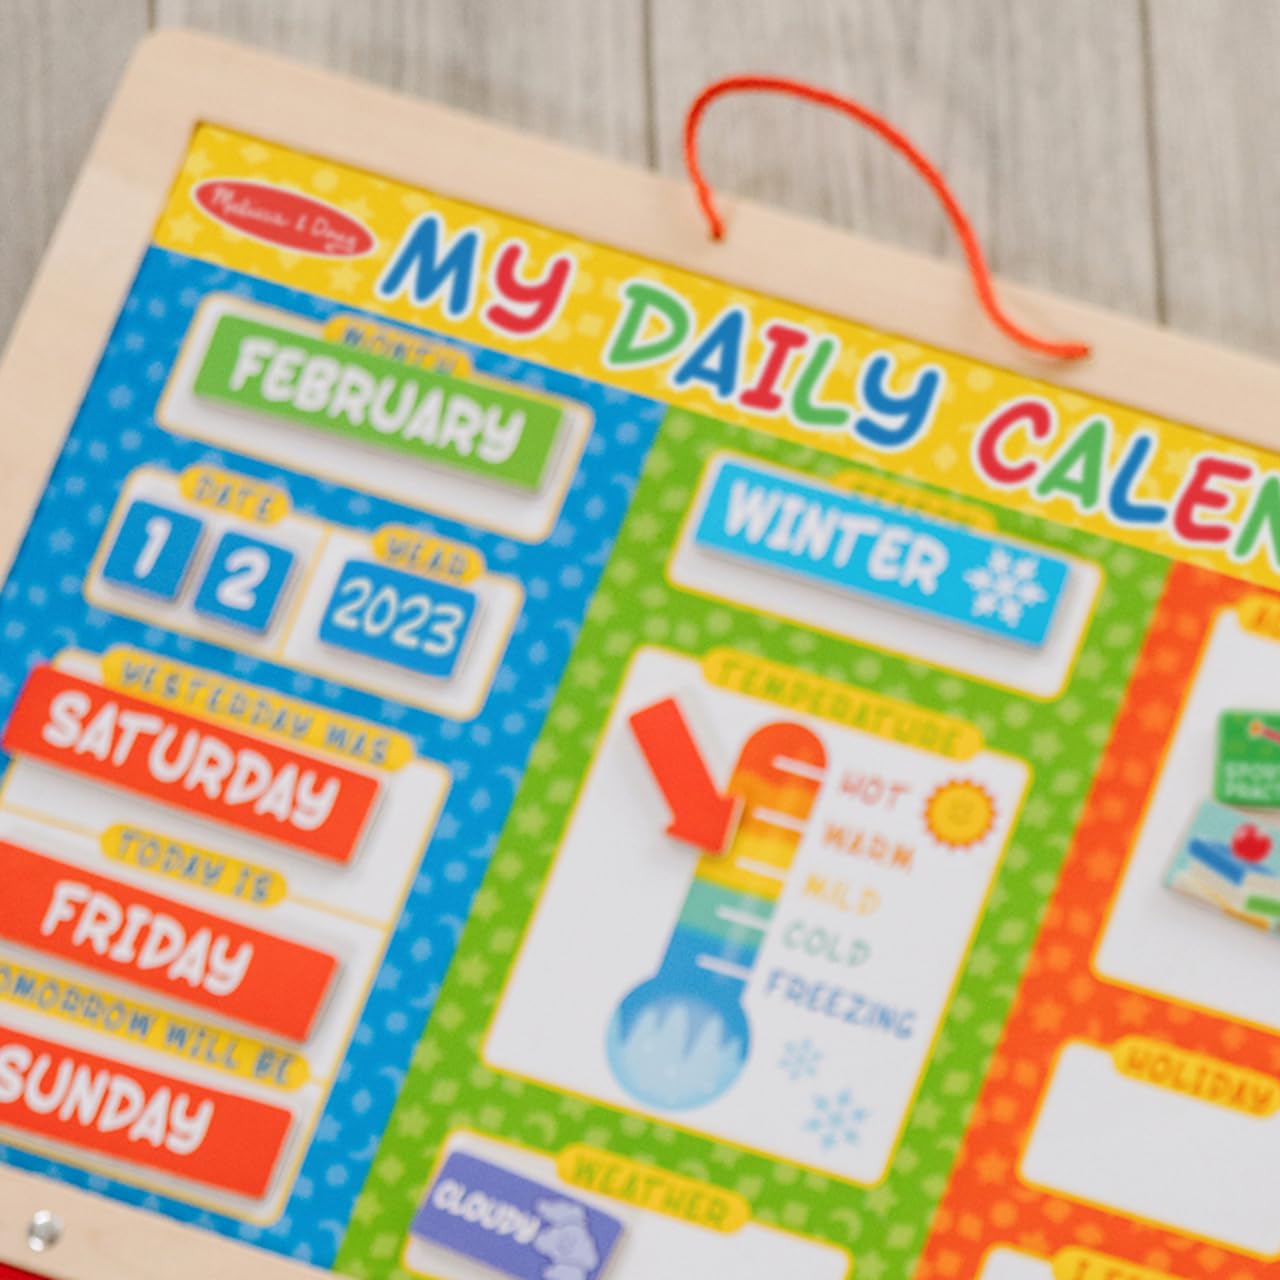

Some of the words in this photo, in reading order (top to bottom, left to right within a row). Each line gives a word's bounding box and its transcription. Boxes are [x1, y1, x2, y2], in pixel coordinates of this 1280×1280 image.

[373, 212, 573, 336] MY
[607, 282, 941, 447] DAILY
[229, 337, 526, 463] FEBRUARY
[194, 474, 274, 521] DATE
[133, 517, 172, 579] 1
[216, 547, 270, 610] 2
[386, 535, 470, 578] YEAR
[724, 479, 949, 594] WINTER
[332, 577, 464, 656] 2023
[121, 661, 312, 736] YESTERDAY
[324, 726, 391, 764] WAS
[720, 658, 961, 751] TEMPERATURE
[43, 690, 340, 830] SATURDAY
[839, 771, 910, 810] HOT
[118, 830, 224, 886] TODAY
[236, 871, 273, 902] IS
[822, 823, 916, 871] WARM
[804, 873, 881, 917] MILD
[41, 880, 254, 995] FRIDAY
[783, 920, 873, 968] COLD
[764, 969, 918, 1039] FREEZING
[166, 1018, 239, 1071] WILL
[252, 1053, 296, 1087] BE
[1129, 1046, 1272, 1109] HOLIDAY
[0, 1043, 215, 1155] SUNDAY
[433, 1179, 542, 1245] CLOUDY
[575, 1153, 731, 1226] WEATHER
